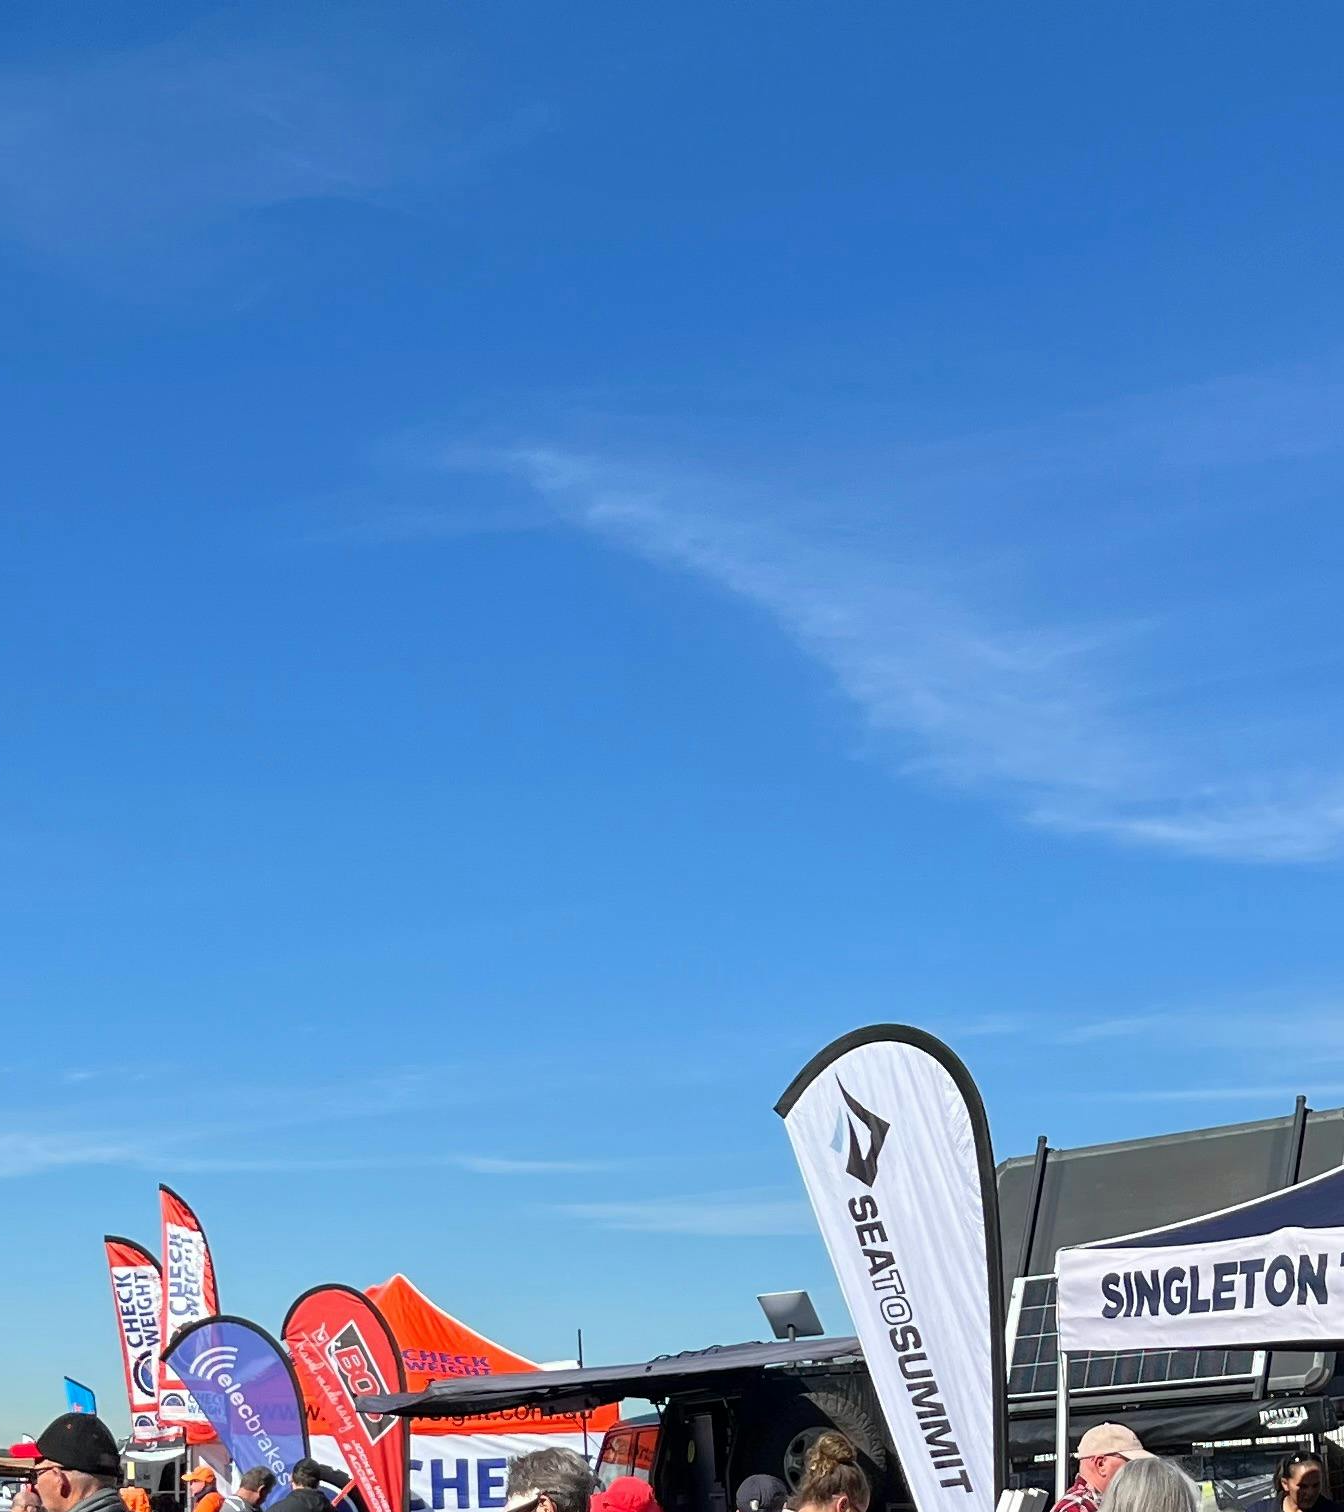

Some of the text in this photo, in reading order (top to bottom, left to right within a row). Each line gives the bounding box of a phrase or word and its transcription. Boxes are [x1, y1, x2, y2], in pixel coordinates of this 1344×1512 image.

[113, 1271, 144, 1349] CHECK
[134, 1271, 162, 1348] WEIGHT
[1101, 1253, 1329, 1320] SINGLETON
[402, 1348, 489, 1367] CHECK
[405, 1361, 492, 1377] WEIGHT
[217, 1372, 293, 1487] elecbrakes
